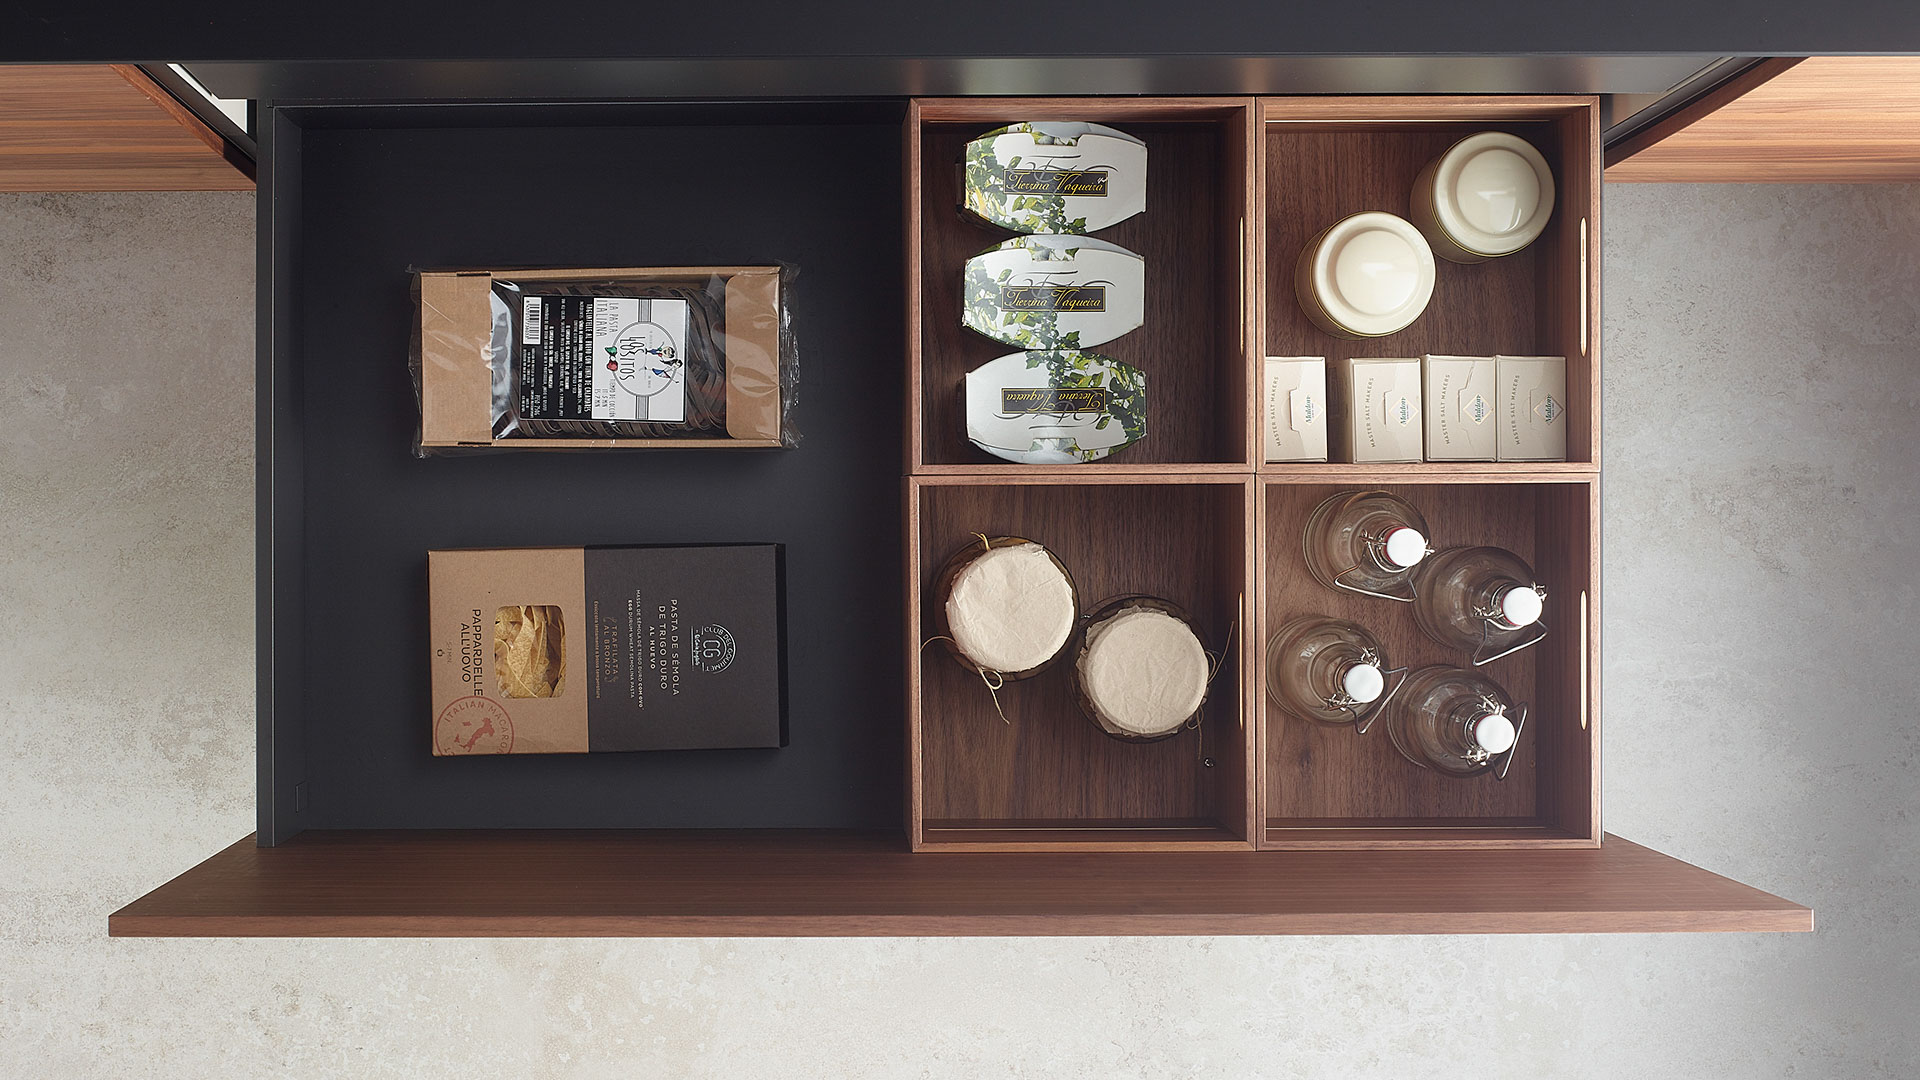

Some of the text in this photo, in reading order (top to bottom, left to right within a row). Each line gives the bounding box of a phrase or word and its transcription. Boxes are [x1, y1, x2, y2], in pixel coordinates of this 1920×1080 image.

[1004, 288, 1101, 311] Tierrina Vaqueira
[596, 299, 608, 337] ITALIANA
[609, 302, 619, 333] LA PASTA
[1006, 388, 1103, 411] Tierrina Vaqueira
[1270, 376, 1279, 402] MAKERS
[1365, 377, 1374, 403] MAKERS
[1441, 374, 1450, 399] MAKERS
[1511, 375, 1520, 400] MAKERS
[1271, 421, 1282, 447] MASTER
[1366, 422, 1376, 448] MASTER
[1441, 419, 1451, 445] MASTER
[1511, 420, 1521, 446] MASTER
[636, 608, 641, 617] DE
[604, 625, 610, 636] AL
[649, 626, 655, 636] AL
[461, 623, 472, 683] ALL'UOVO
[472, 609, 483, 696] PAPPARDELLE
[658, 605, 668, 690] DE TRIGO DURO
[670, 599, 680, 696] PASTA DE SÉMOLA
[703, 640, 721, 658] CG
[704, 626, 733, 672] CLUB DEL GOURMET
[445, 701, 485, 722] ITALIAN
